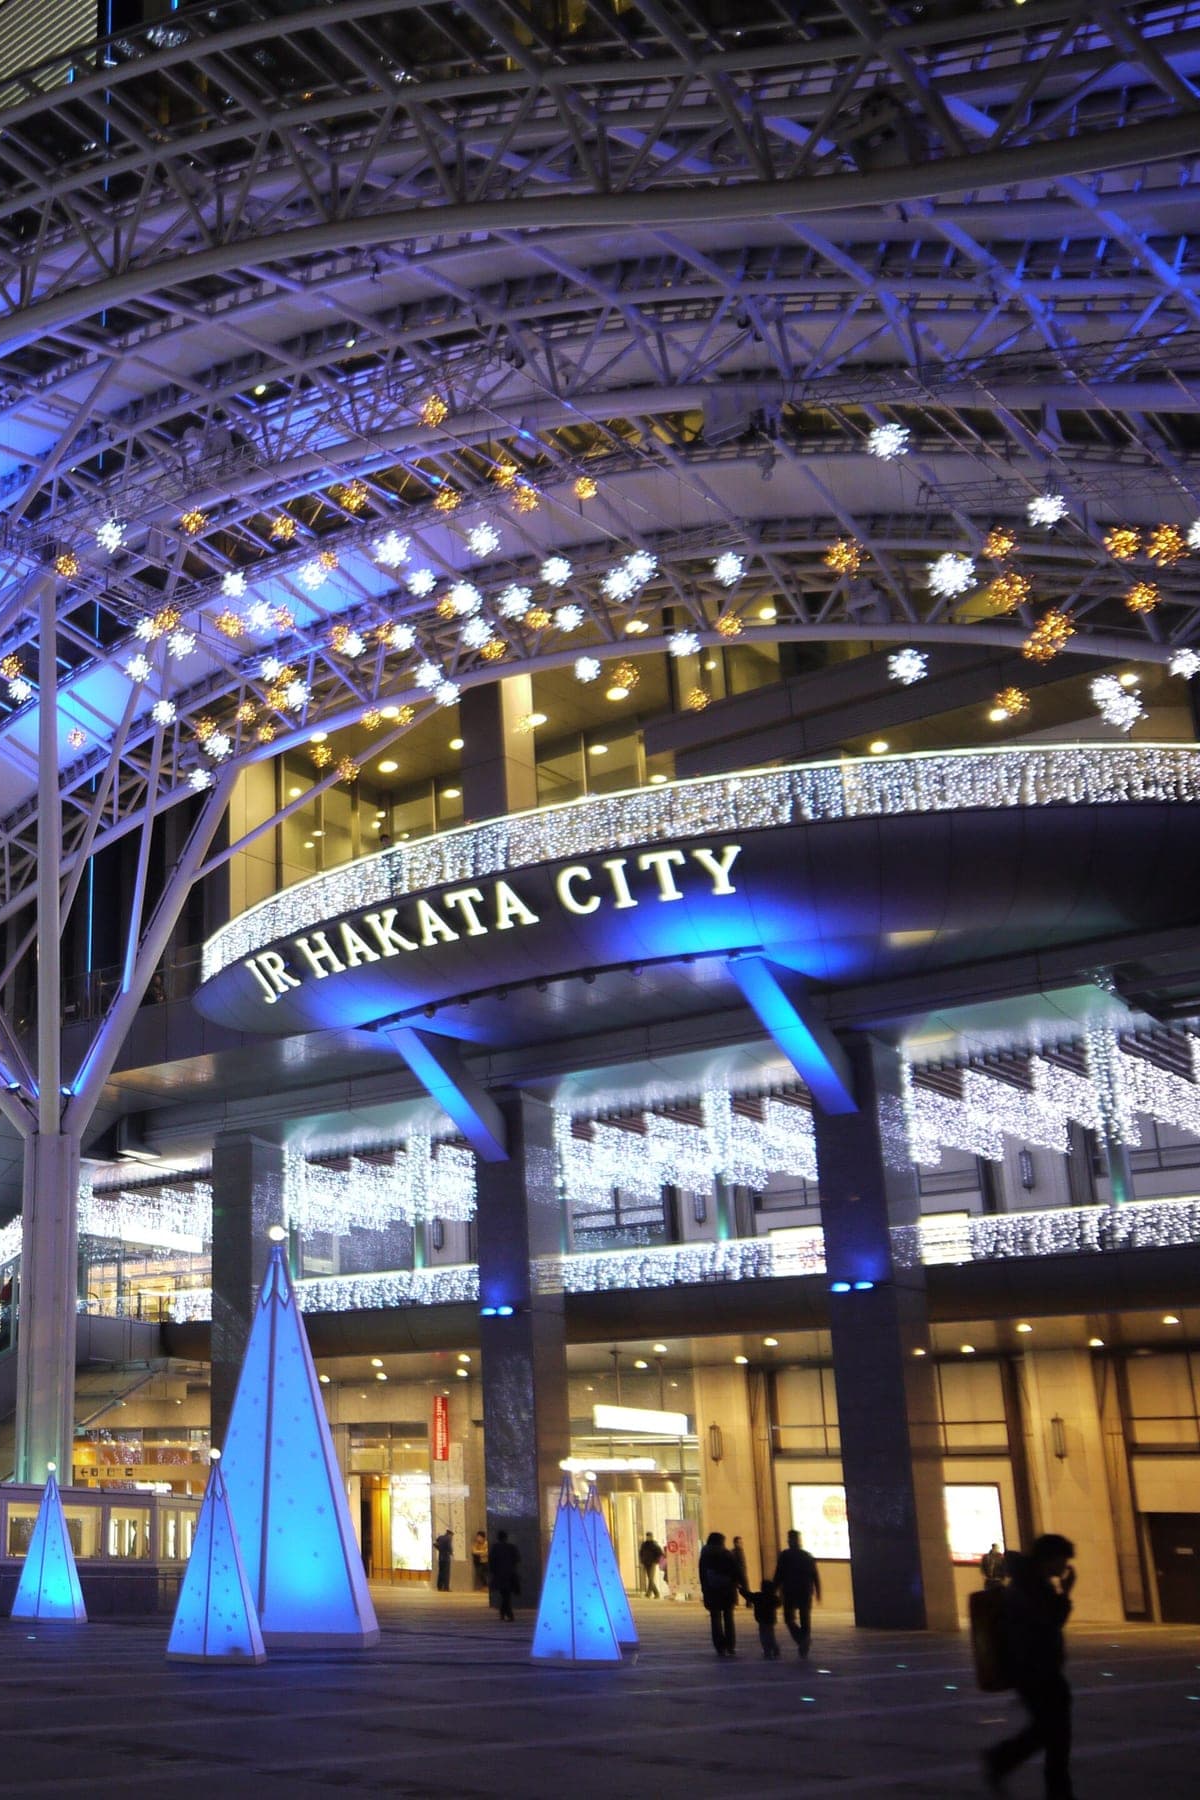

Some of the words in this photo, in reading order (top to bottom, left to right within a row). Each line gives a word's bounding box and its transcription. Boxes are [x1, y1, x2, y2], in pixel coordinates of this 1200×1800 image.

[245, 956, 301, 1004] JR
[296, 879, 539, 979] HAKATA
[557, 844, 742, 915] CITY
